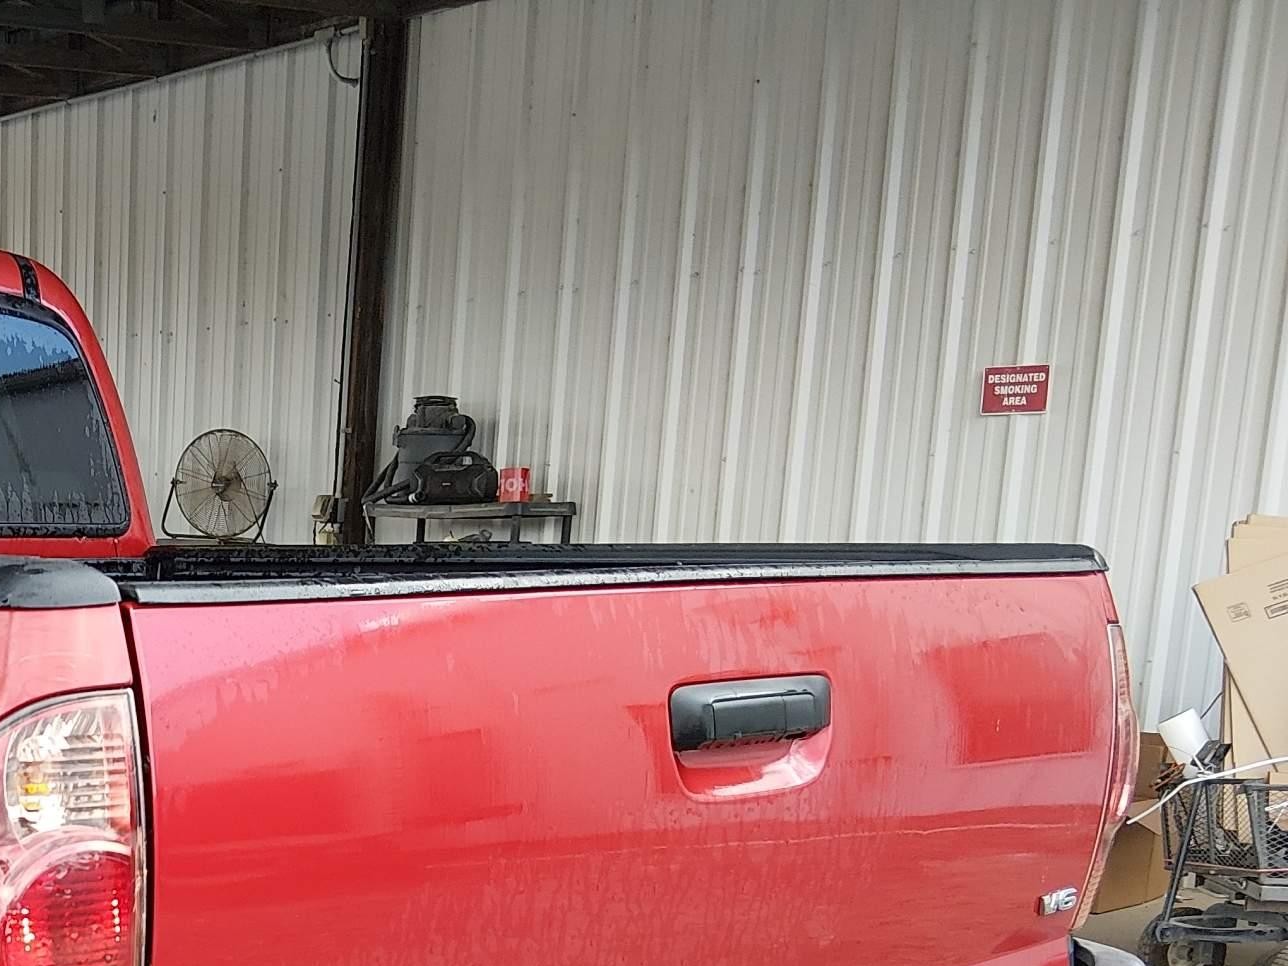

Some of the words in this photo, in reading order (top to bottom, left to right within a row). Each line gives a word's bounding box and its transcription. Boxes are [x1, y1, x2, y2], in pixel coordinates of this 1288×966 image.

[988, 372, 1046, 384] DESIGNATED
[994, 384, 1038, 395] SMOKING
[1002, 396, 1027, 406] AREA
[1041, 888, 1078, 914] V6
